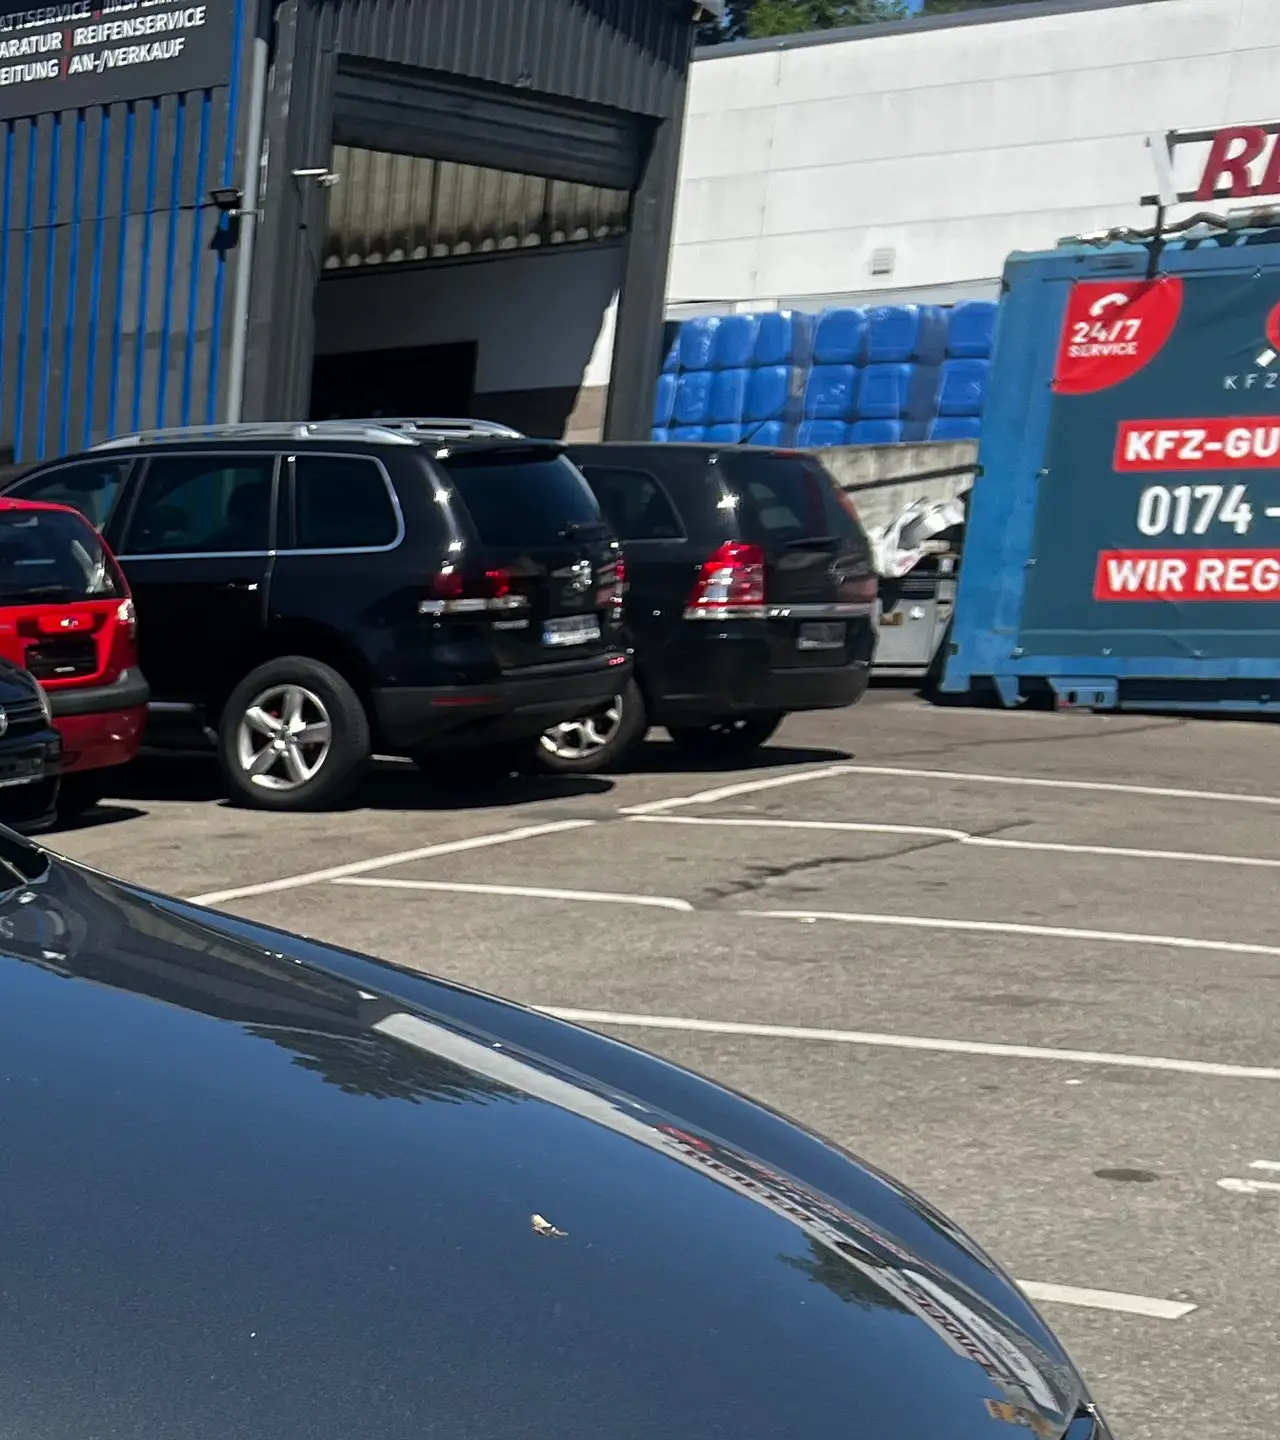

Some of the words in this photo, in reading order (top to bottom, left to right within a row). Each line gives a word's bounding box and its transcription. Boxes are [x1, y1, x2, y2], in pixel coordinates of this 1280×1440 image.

[73, 6, 207, 47] REIFENSERVICE
[68, 37, 186, 74] AN-/VERKAUF
[1071, 317, 1142, 344] 24/7
[1068, 341, 1137, 358] SERVICE
[1124, 426, 1280, 462] KFZ-GU
[1136, 484, 1254, 537] 0174
[1106, 557, 1187, 593] WIR
[1195, 557, 1280, 593] REG
